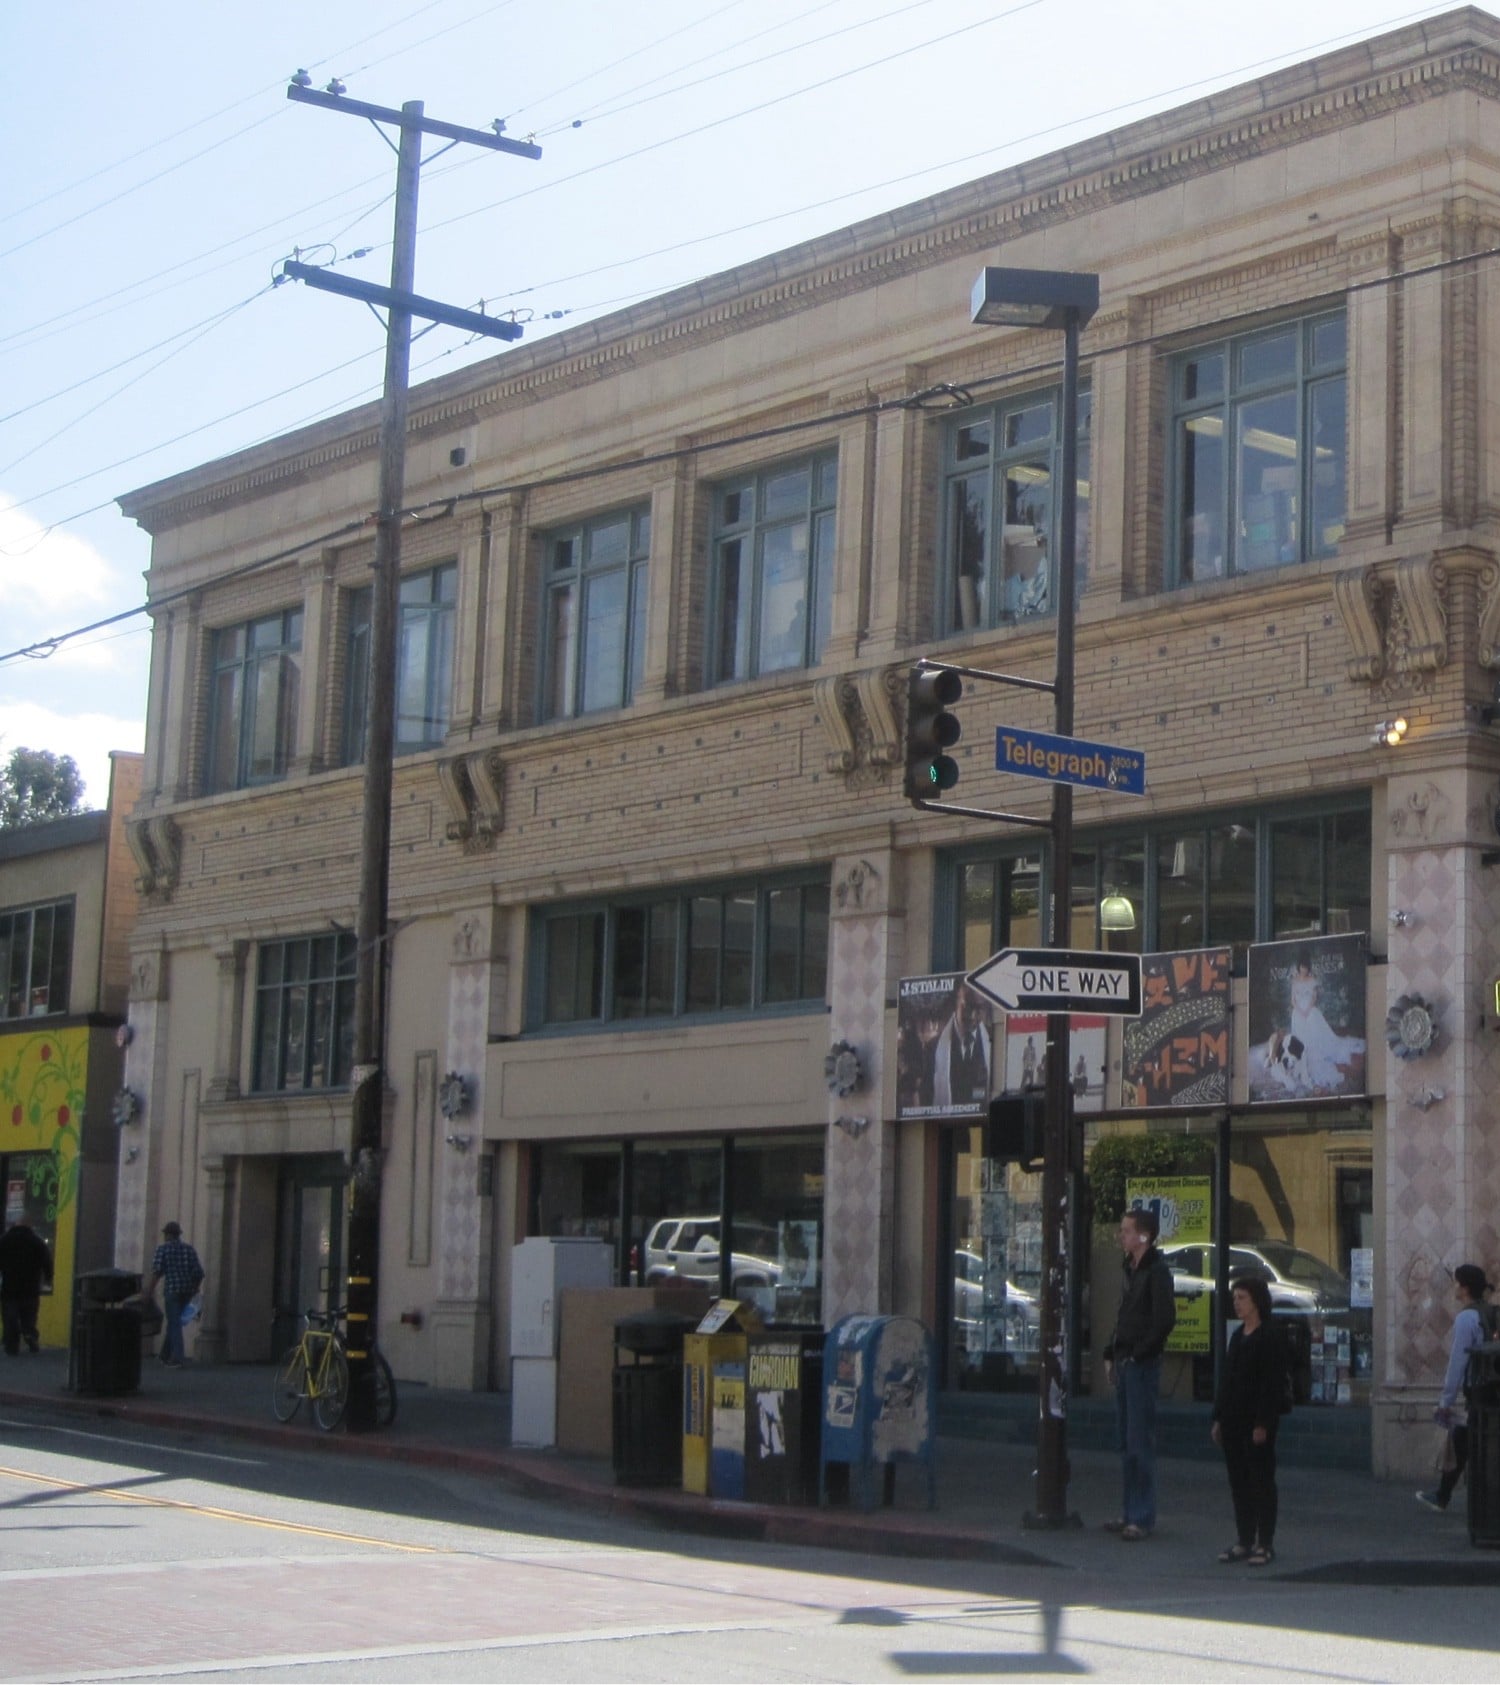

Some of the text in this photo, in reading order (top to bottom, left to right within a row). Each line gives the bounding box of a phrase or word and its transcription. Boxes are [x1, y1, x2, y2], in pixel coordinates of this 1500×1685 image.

[1002, 735, 1106, 781] Telegraph
[900, 978, 955, 997] J.STALIN
[1022, 969, 1123, 996] ONE WAY
[750, 1354, 799, 1390] GUARDIAN
